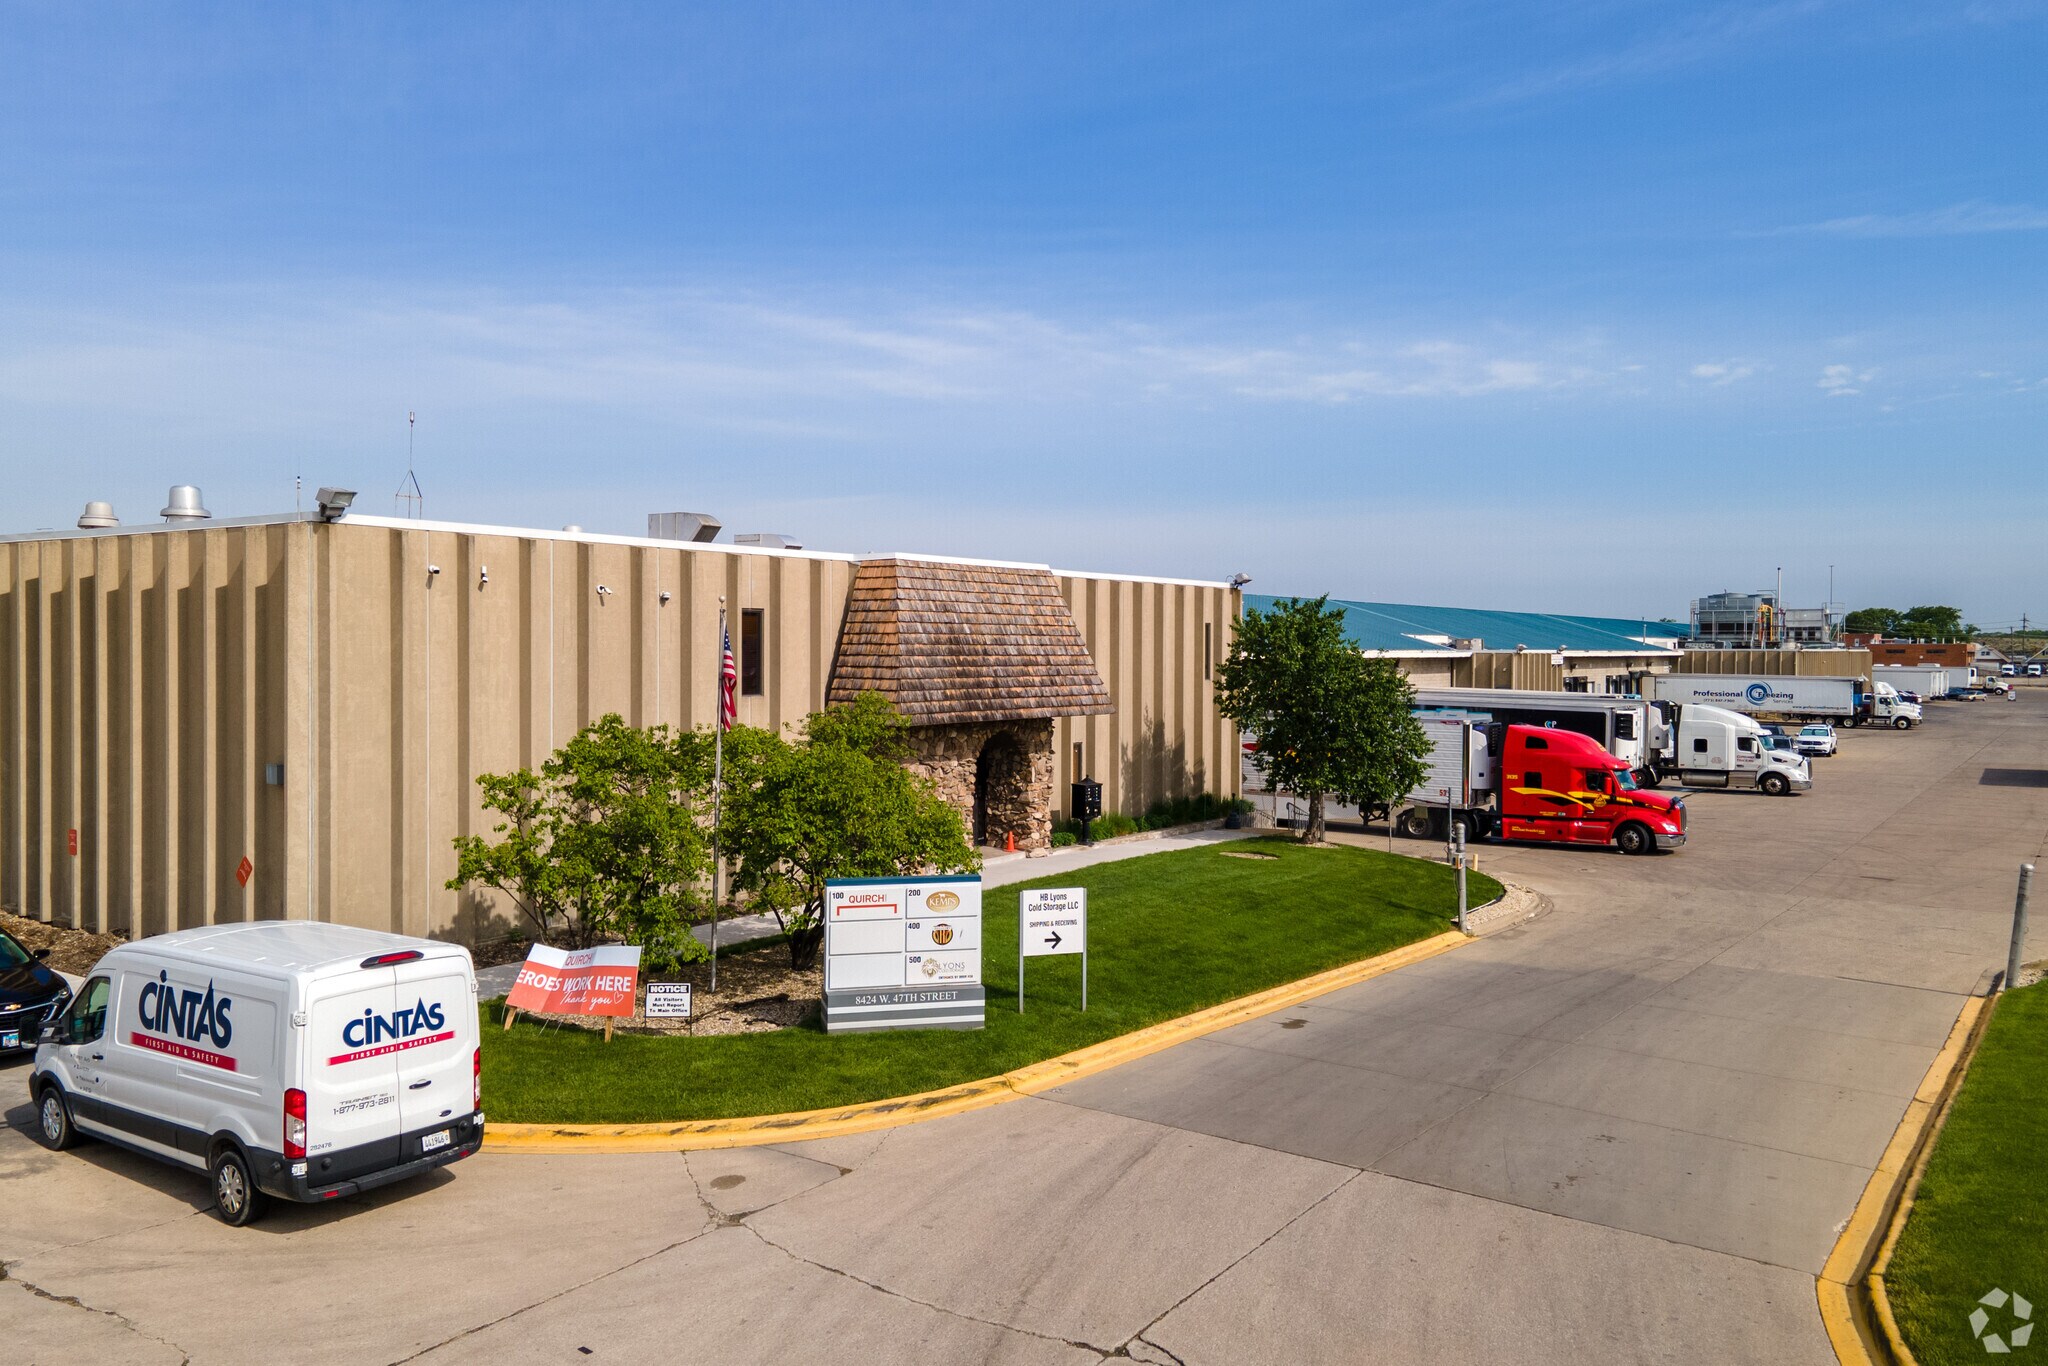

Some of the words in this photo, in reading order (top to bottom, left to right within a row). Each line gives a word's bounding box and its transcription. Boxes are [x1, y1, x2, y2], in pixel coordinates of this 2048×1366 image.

[1758, 691, 1794, 700] Freezing
[848, 894, 885, 904] QUIRCH
[929, 896, 956, 906] KEMPS
[1040, 893, 1049, 901] HB
[1050, 893, 1067, 902] Lyons
[1029, 904, 1042, 912] Cold
[1043, 902, 1066, 912] Storage
[1068, 901, 1078, 910] LLC
[565, 953, 592, 966] QUIRCH
[516, 969, 562, 992] EROES
[562, 975, 594, 992] WORK
[595, 975, 632, 992] HERE
[560, 990, 587, 1005] Thank
[591, 995, 613, 1011] you
[855, 995, 877, 1005] 8424
[879, 994, 891, 1004] W.
[893, 993, 917, 1003] 47TH
[920, 991, 958, 1002] STREET
[145, 1038, 165, 1050] FIRST
[168, 1044, 179, 1054] AID
[192, 1050, 219, 1064] SAFETY
[350, 1050, 376, 1060] FIRST
[408, 1036, 438, 1048] SAFETY
